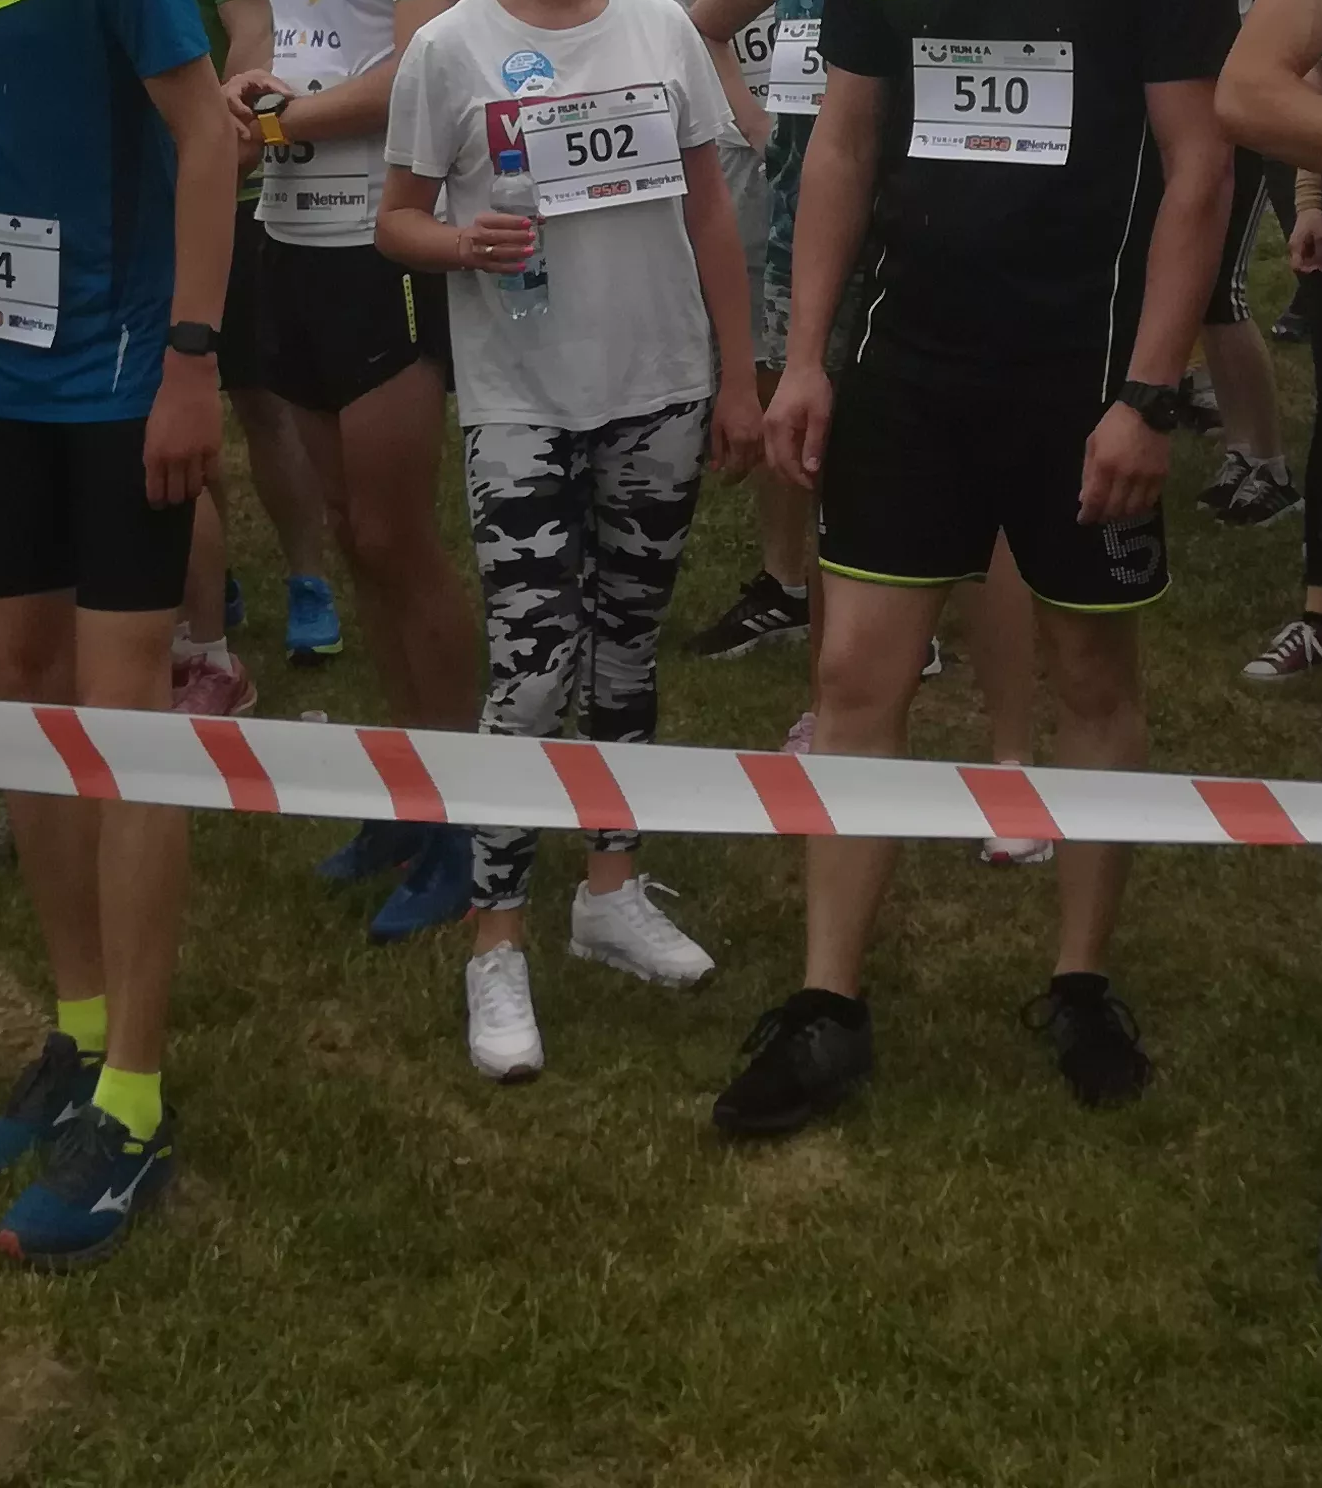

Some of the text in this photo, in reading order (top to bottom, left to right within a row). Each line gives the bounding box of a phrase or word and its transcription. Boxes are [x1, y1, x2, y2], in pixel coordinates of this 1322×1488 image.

[953, 75, 1030, 115] 510
[565, 124, 638, 167] 502
[1027, 139, 1067, 151] Netrium
[647, 173, 683, 186] Netrium
[310, 191, 366, 206] Netrium
